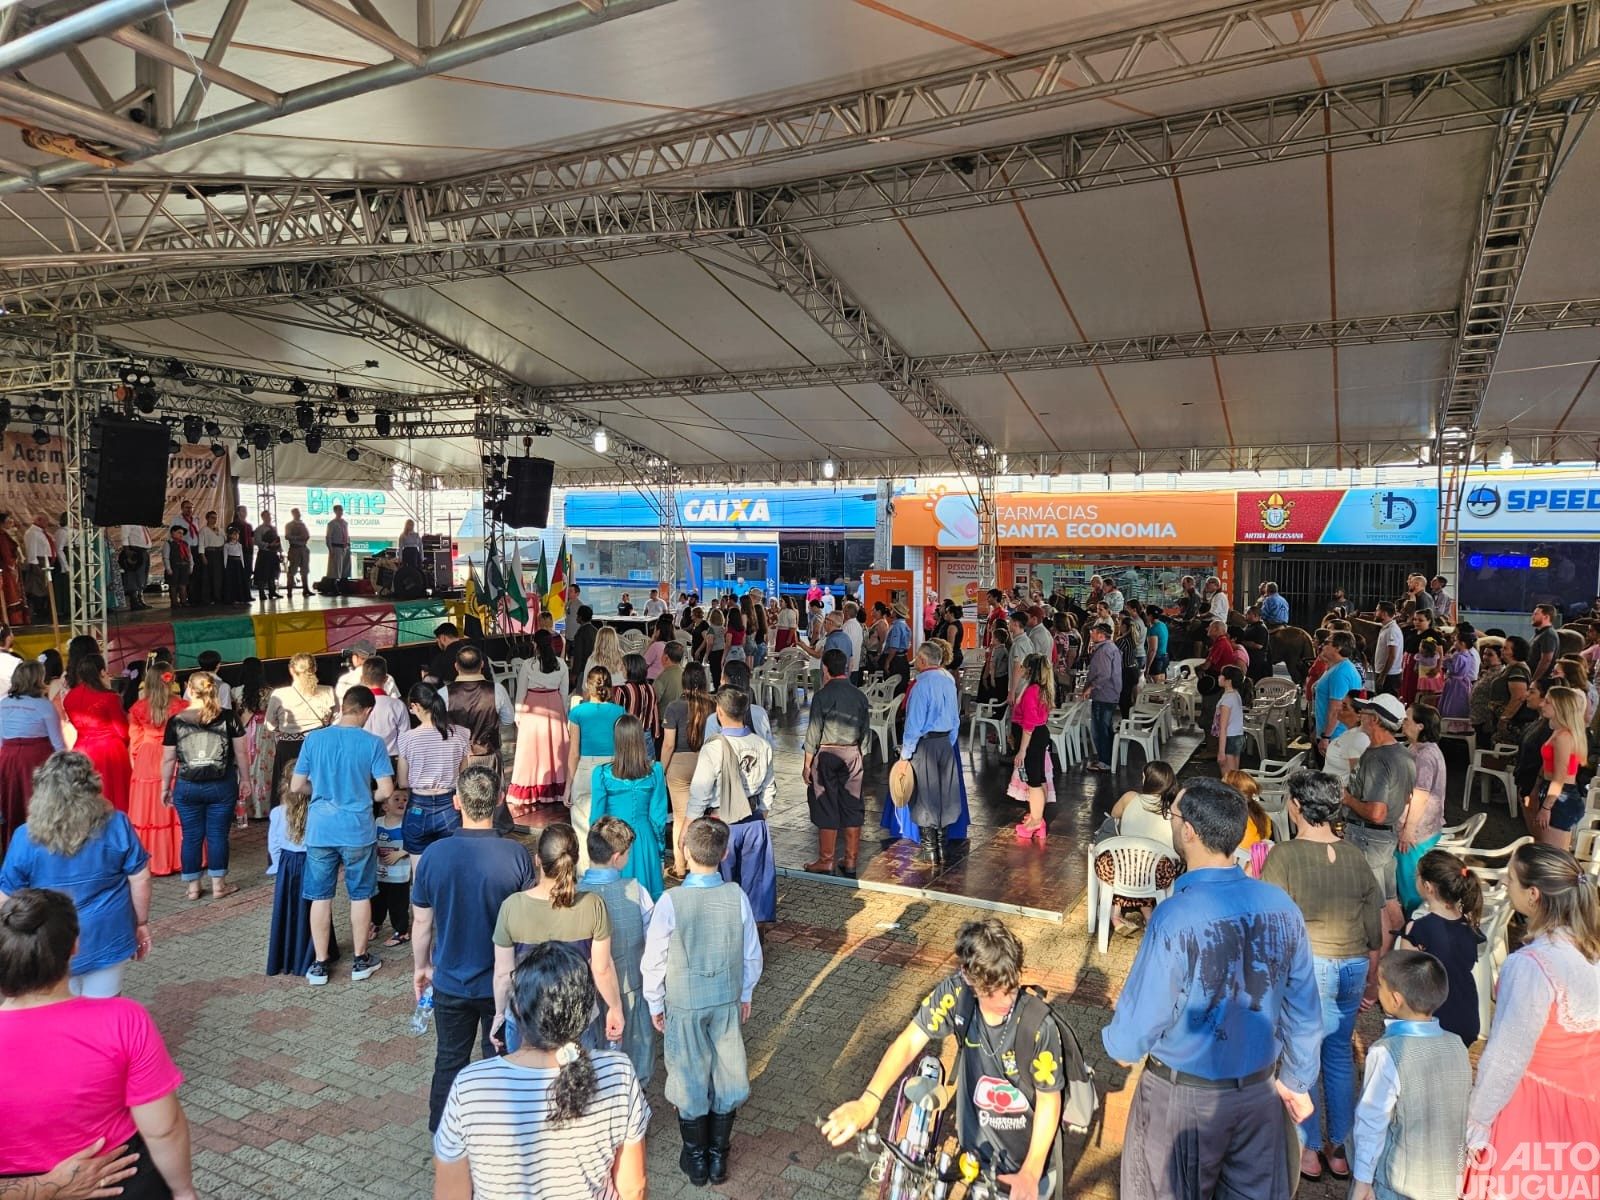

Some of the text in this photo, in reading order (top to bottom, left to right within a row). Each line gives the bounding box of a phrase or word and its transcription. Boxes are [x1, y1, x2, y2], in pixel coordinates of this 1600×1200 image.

[12, 443, 213, 473] Acam rrapo
[168, 473, 217, 489] len/RS
[307, 487, 386, 515] Biome
[683, 499, 770, 522] CAIXA
[996, 503, 1098, 521] FARMÁCIAS
[997, 523, 1177, 538] SANTA ECONOMIA
[947, 563, 977, 571] DESCON
